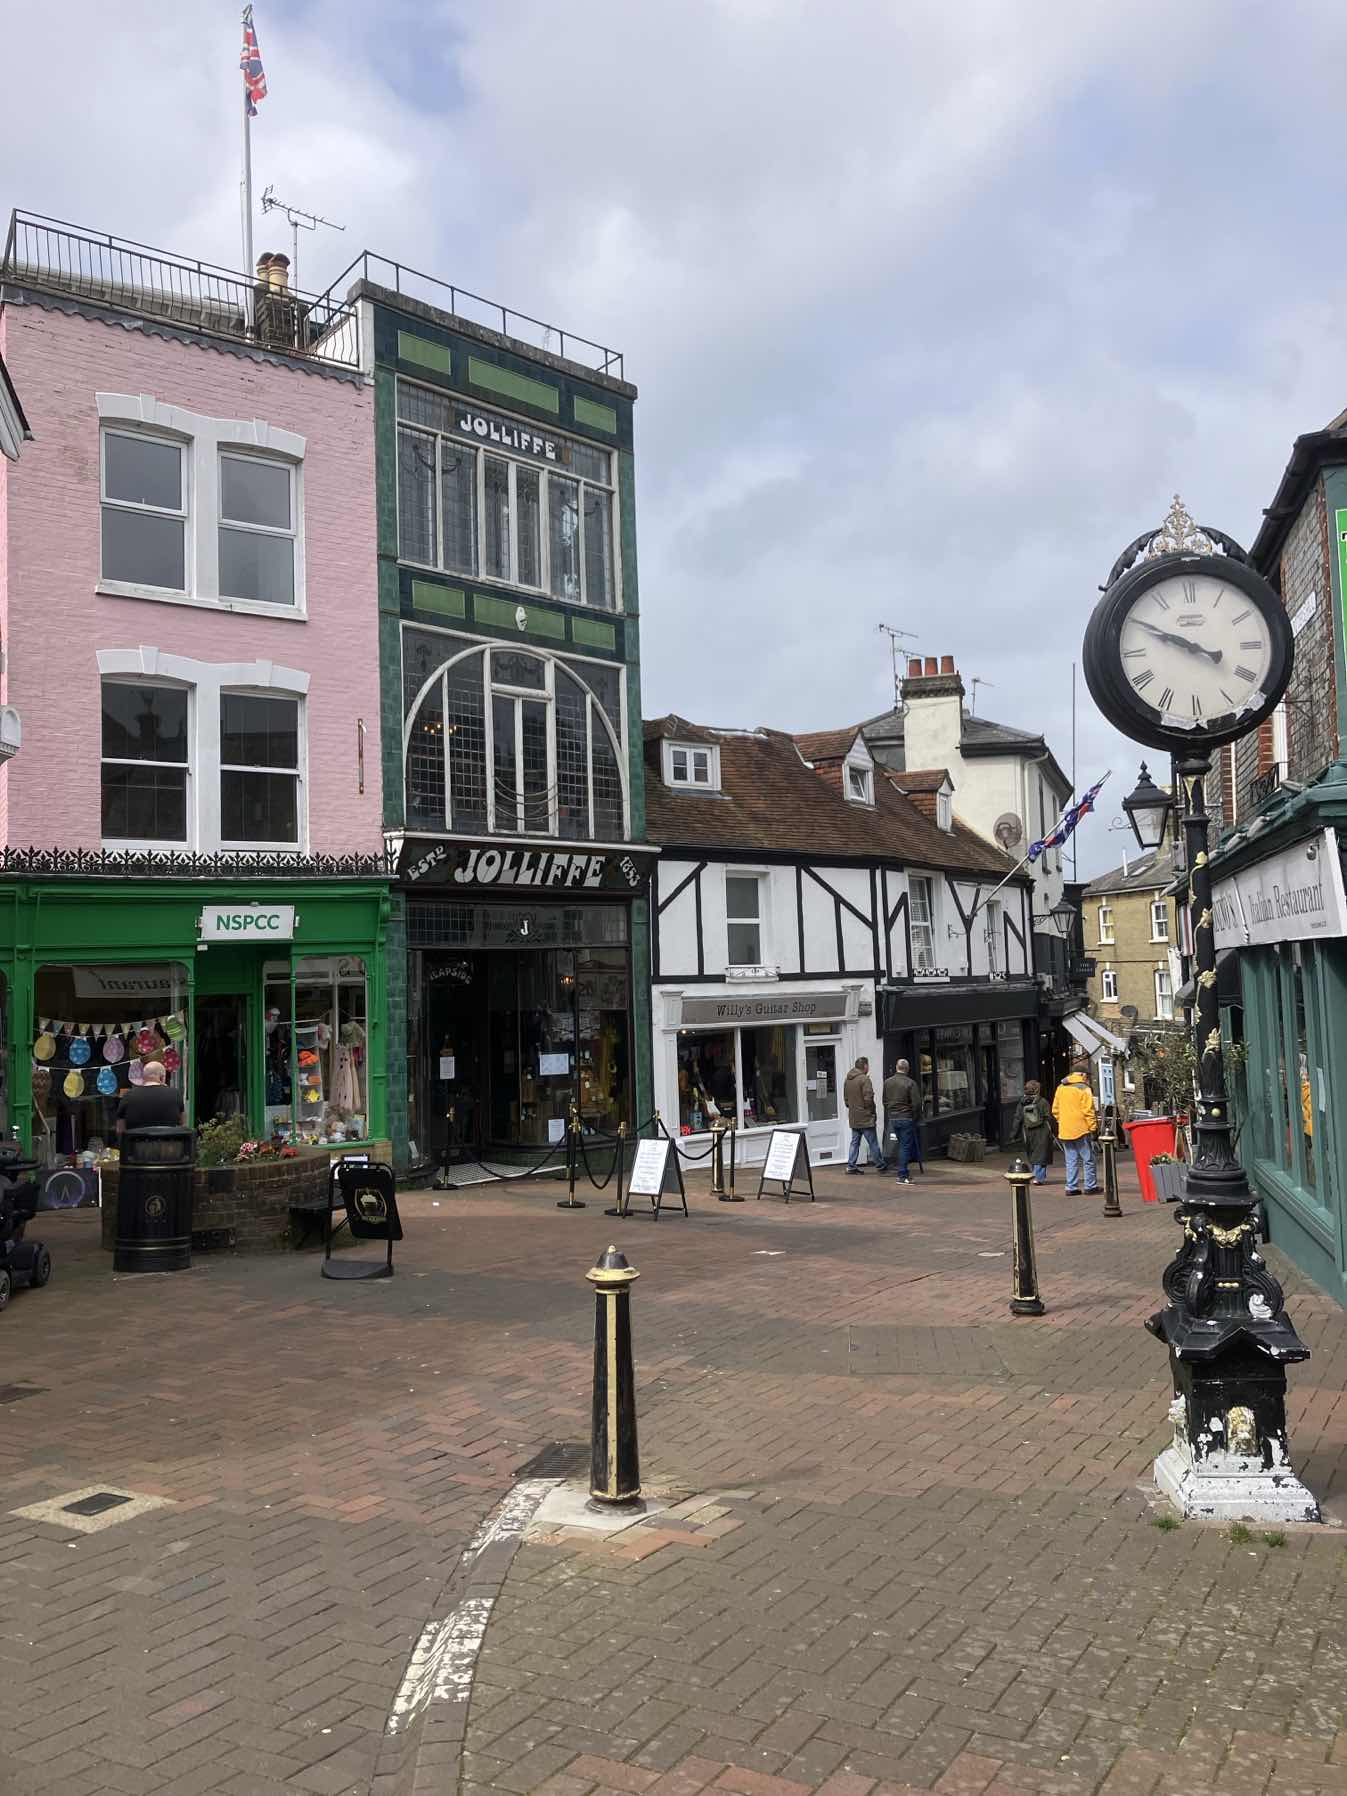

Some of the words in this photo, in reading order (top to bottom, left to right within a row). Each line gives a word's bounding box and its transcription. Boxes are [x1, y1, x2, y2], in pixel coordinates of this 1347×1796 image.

[460, 414, 556, 460] JOLLIFFE
[454, 849, 606, 888] JOLLIFFE
[619, 856, 641, 887] 1853
[1273, 884, 1325, 919] Restaurant
[216, 914, 280, 931] NSPCC
[717, 1004, 752, 1018] Willy's
[755, 1002, 789, 1015] Guitar
[792, 1001, 817, 1015] Shop
